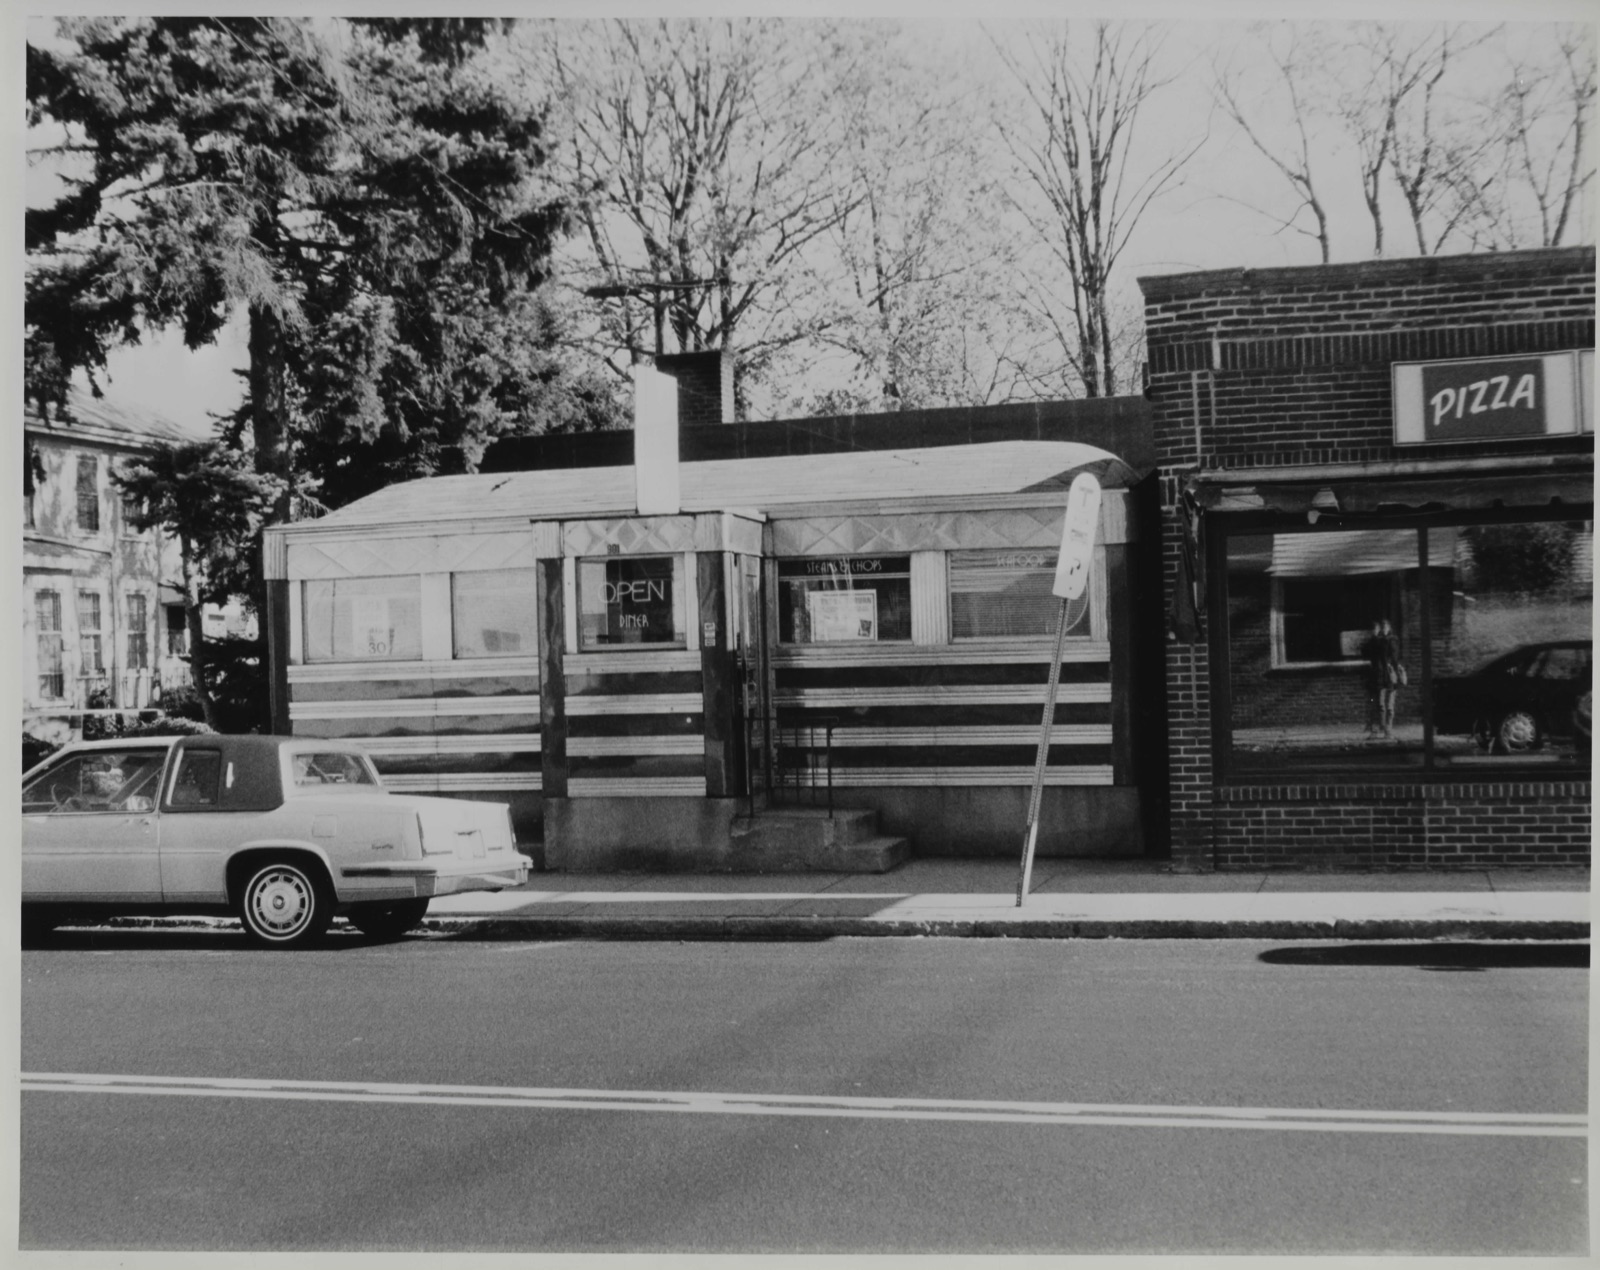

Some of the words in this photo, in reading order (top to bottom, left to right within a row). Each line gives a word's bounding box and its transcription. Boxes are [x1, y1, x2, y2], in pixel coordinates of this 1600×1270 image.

[1430, 374, 1535, 426] PIZZA
[851, 559, 882, 573] CHOPS
[597, 579, 664, 604] OPEN
[619, 613, 649, 628] DINER
